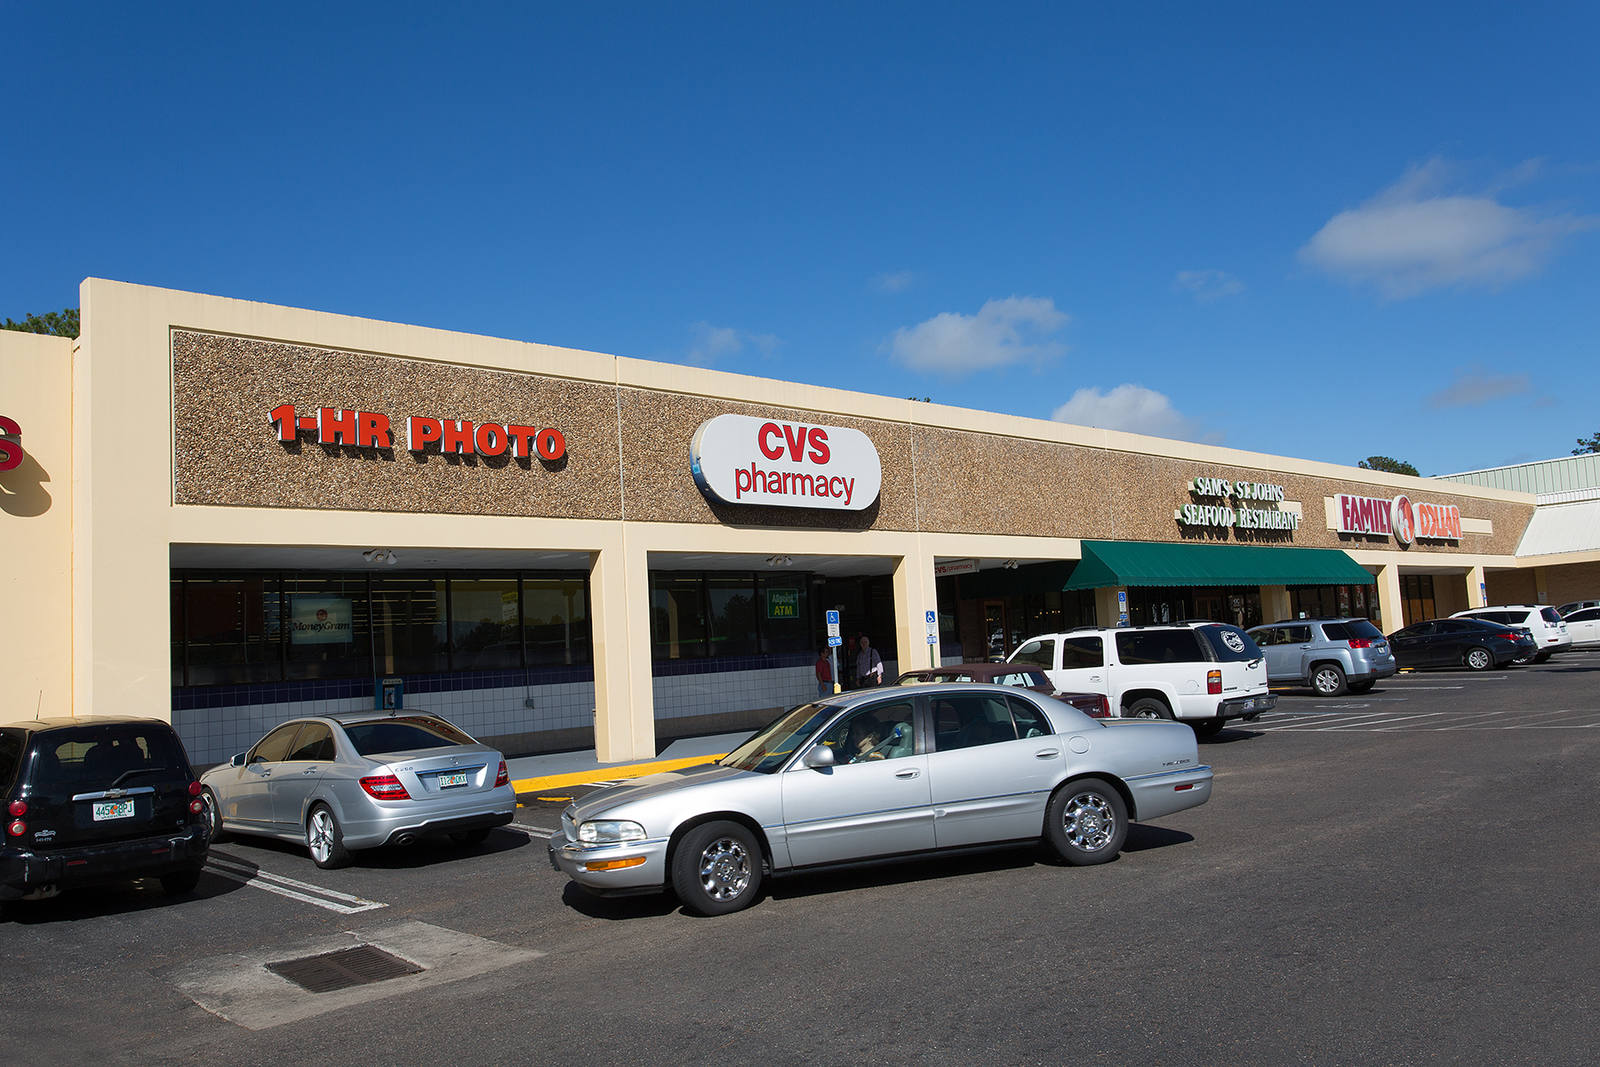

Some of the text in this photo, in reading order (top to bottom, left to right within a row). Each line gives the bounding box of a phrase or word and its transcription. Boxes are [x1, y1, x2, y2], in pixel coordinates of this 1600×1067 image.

[268, 403, 567, 462] 1-HR PHOTO
[757, 422, 831, 465] CVS
[735, 461, 855, 506] pharmacy
[1195, 477, 1232, 498] SAM'S
[1182, 503, 1300, 531] SEAFOOD RESTAURANT
[1340, 495, 1463, 539] FAMILY DOLLAR
[292, 621, 351, 632] MoneyGram
[774, 605, 793, 616] ATM
